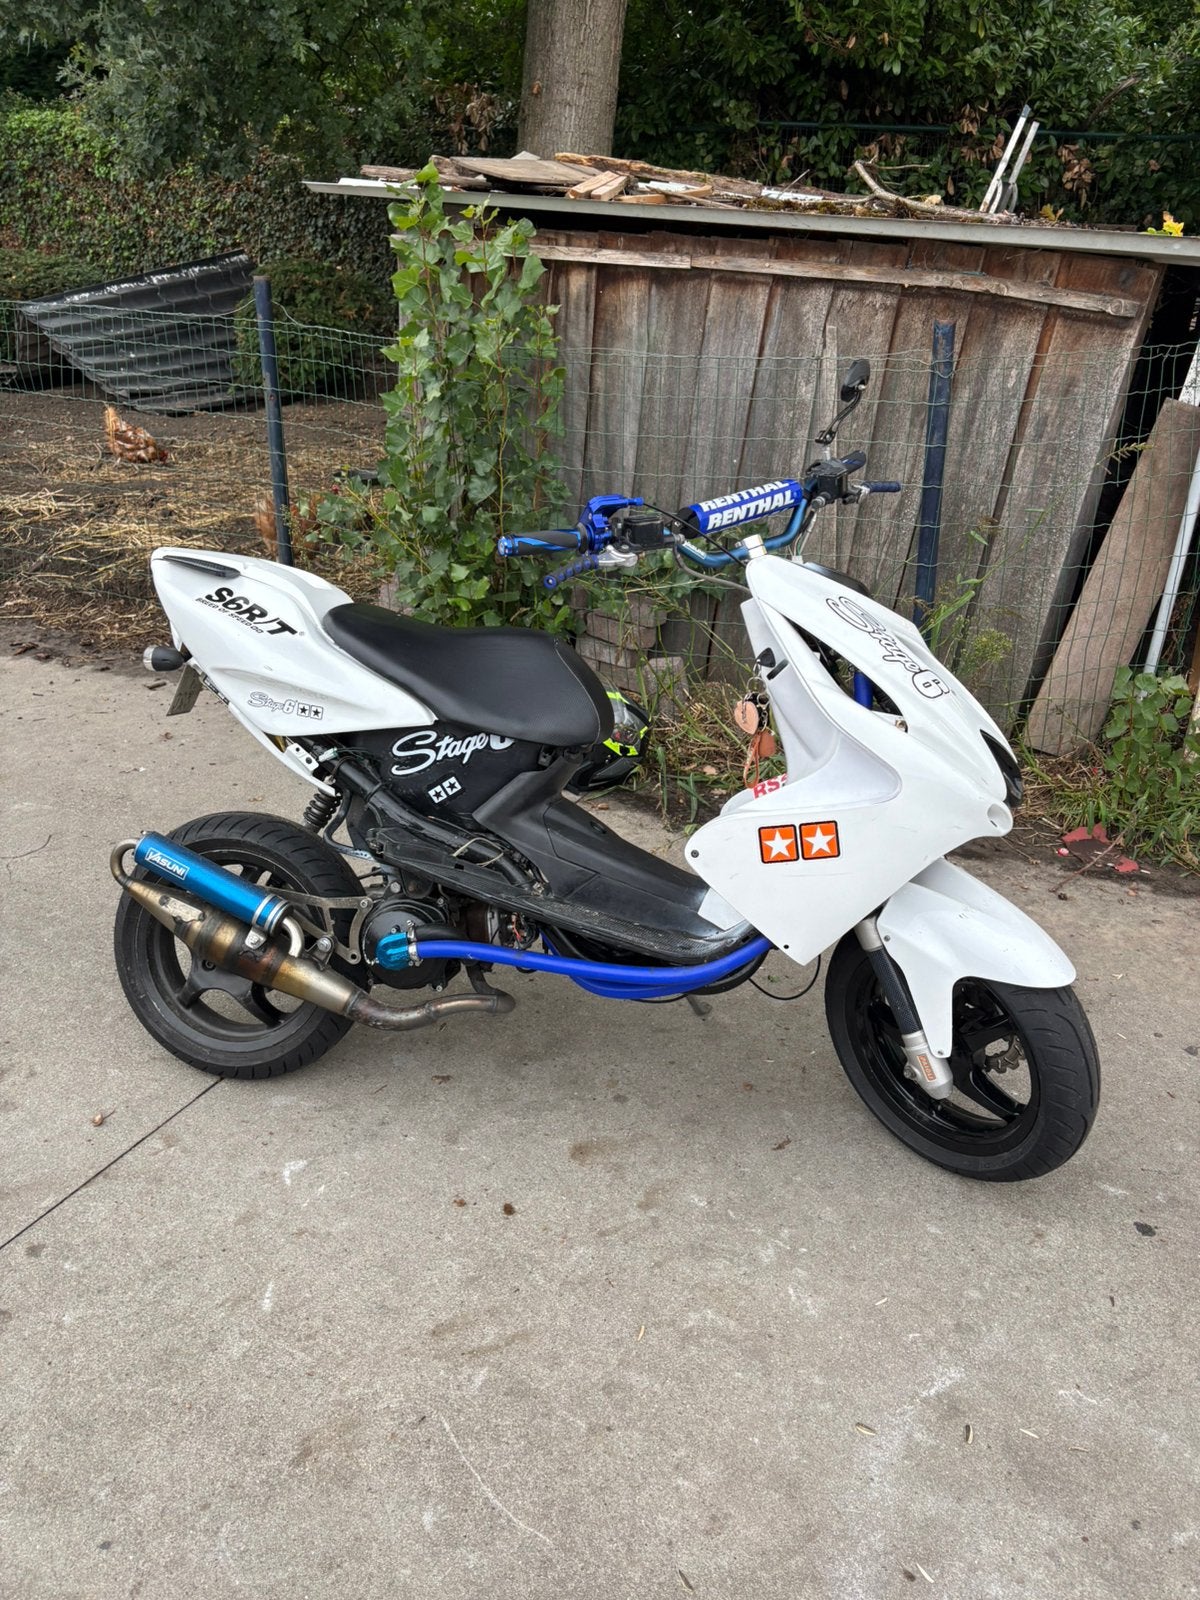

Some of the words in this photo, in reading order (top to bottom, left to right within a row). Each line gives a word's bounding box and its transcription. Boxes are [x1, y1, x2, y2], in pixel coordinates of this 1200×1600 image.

[699, 481, 789, 512] RENTHAL
[706, 490, 795, 530] RENTHAL
[148, 850, 188, 877] YASUNI
